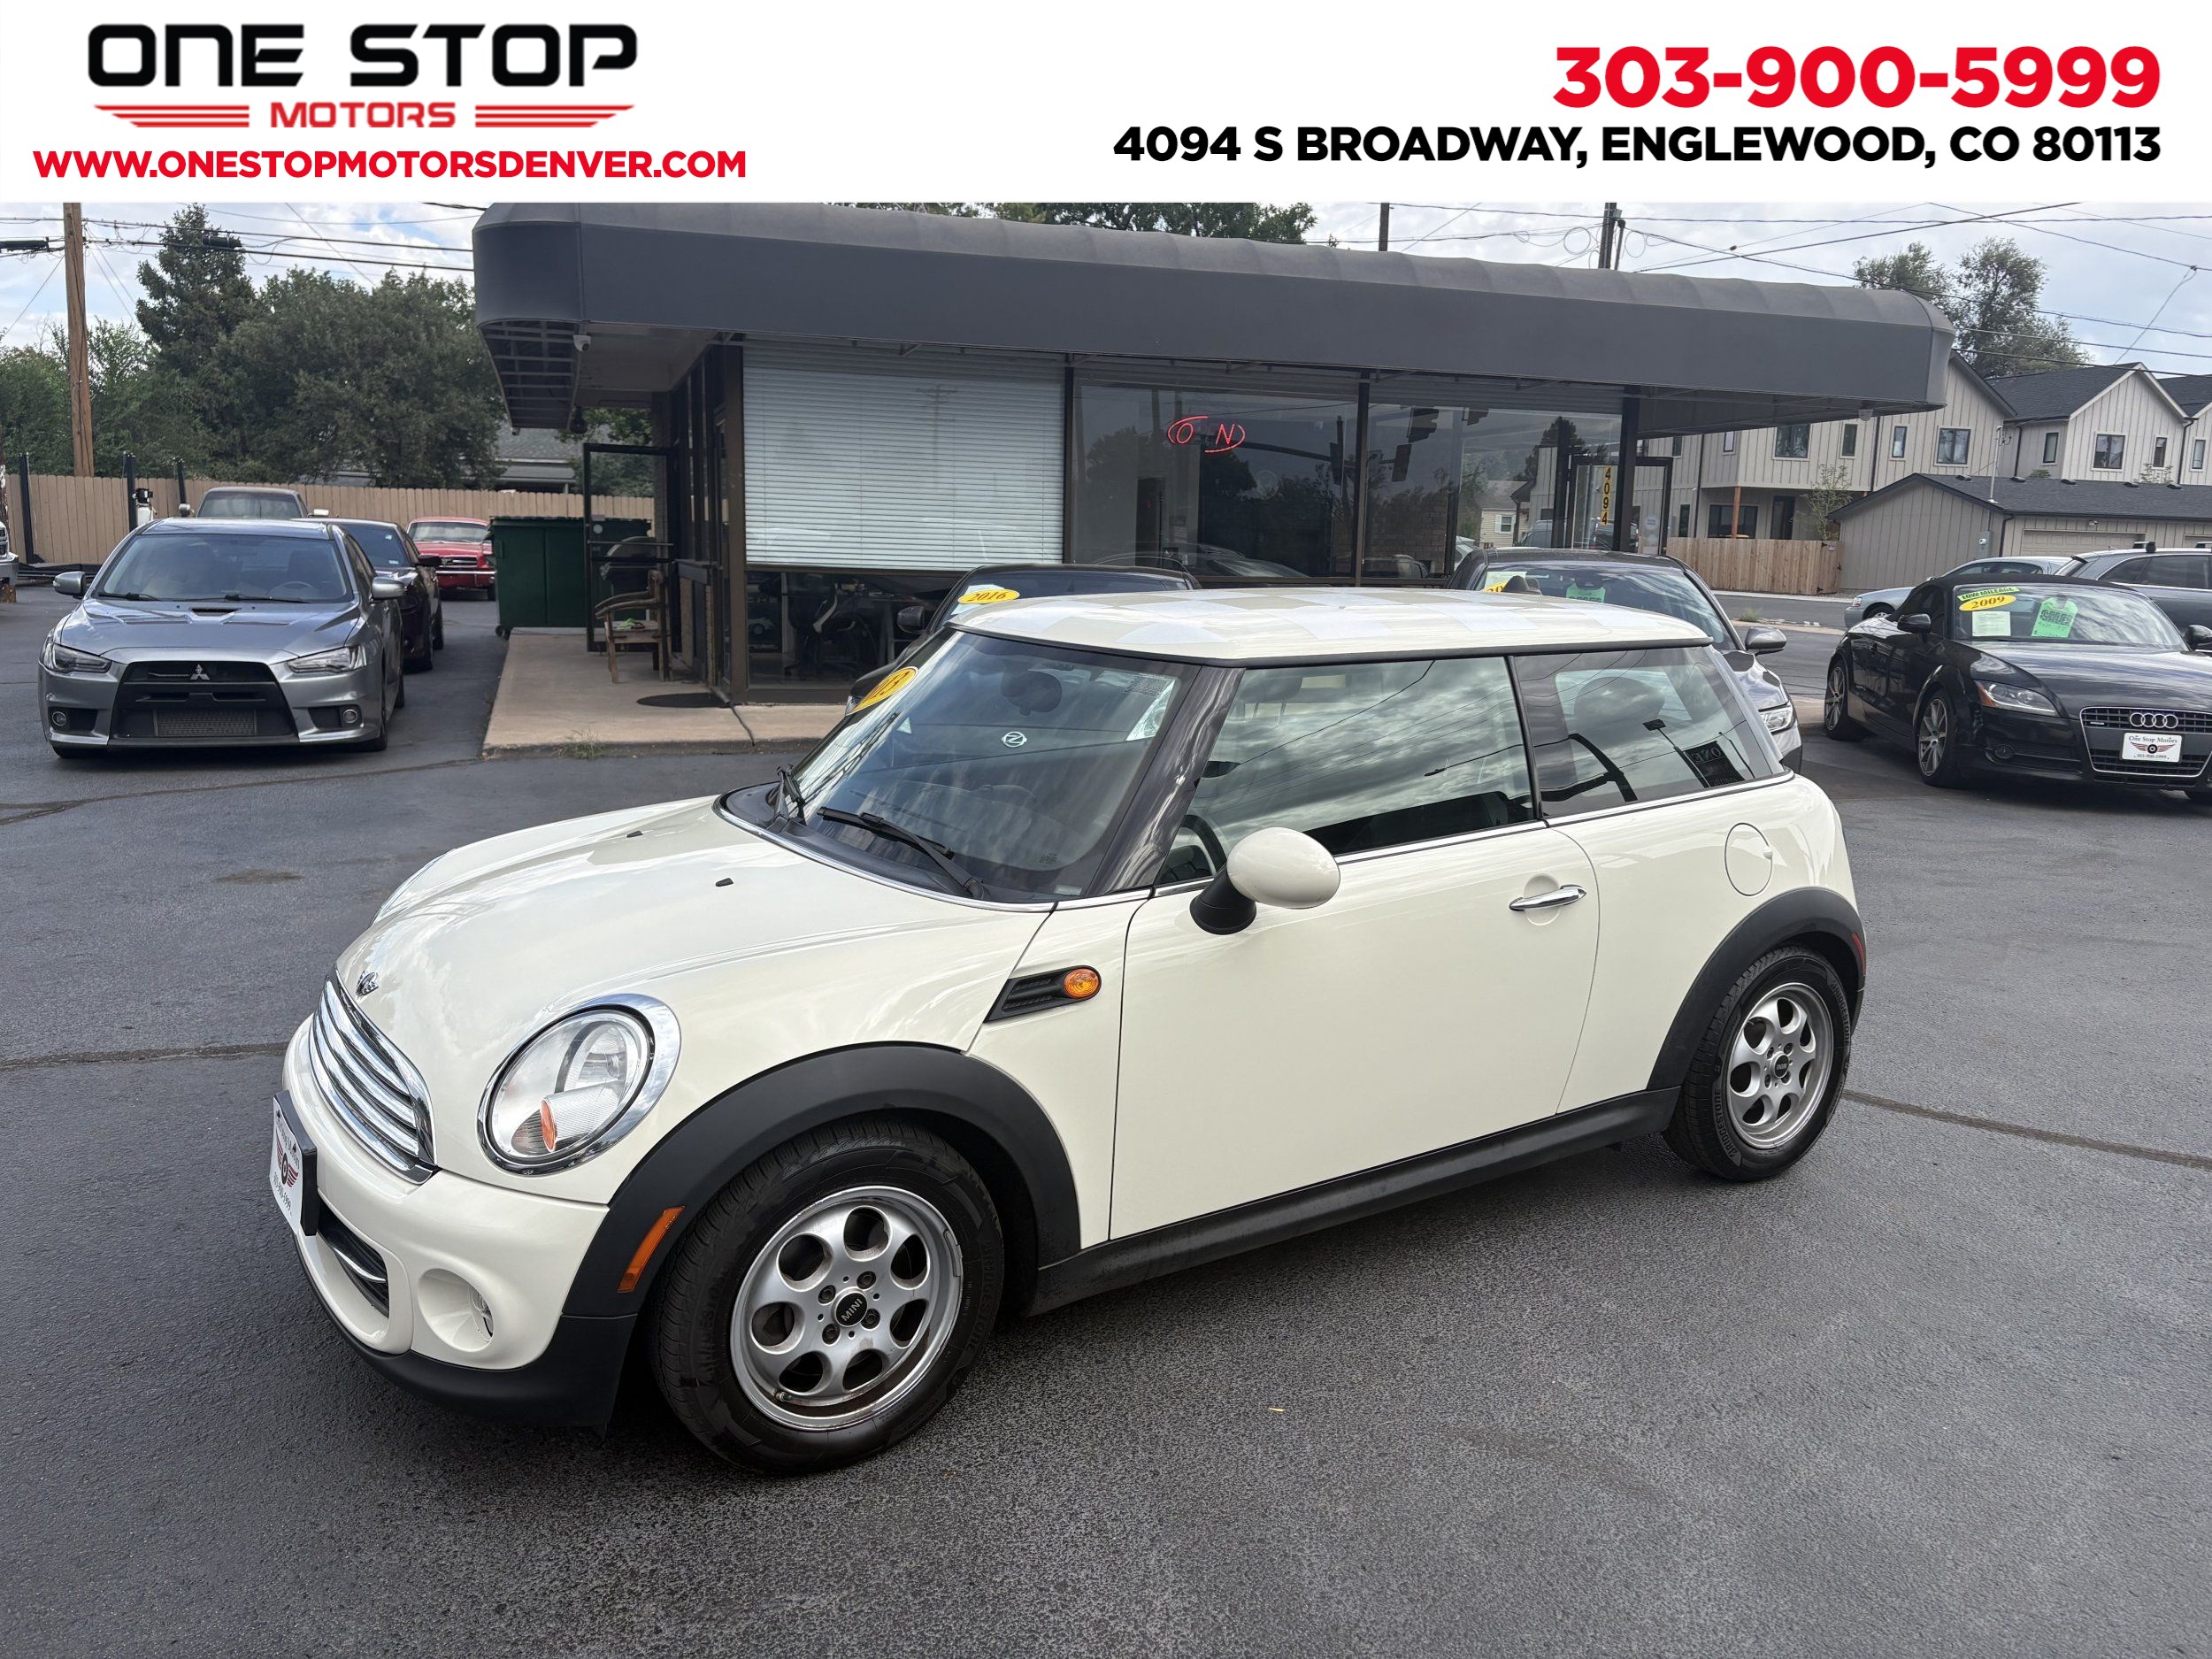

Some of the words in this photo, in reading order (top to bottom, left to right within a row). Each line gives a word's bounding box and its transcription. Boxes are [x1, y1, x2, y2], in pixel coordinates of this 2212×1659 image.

[1601, 466, 1612, 526] 4094
[965, 591, 1009, 603] 2016
[1970, 595, 2006, 610] 2009
[1714, 1089, 1737, 1159] BRIDGESTONE
[841, 1298, 863, 1321] MINI
